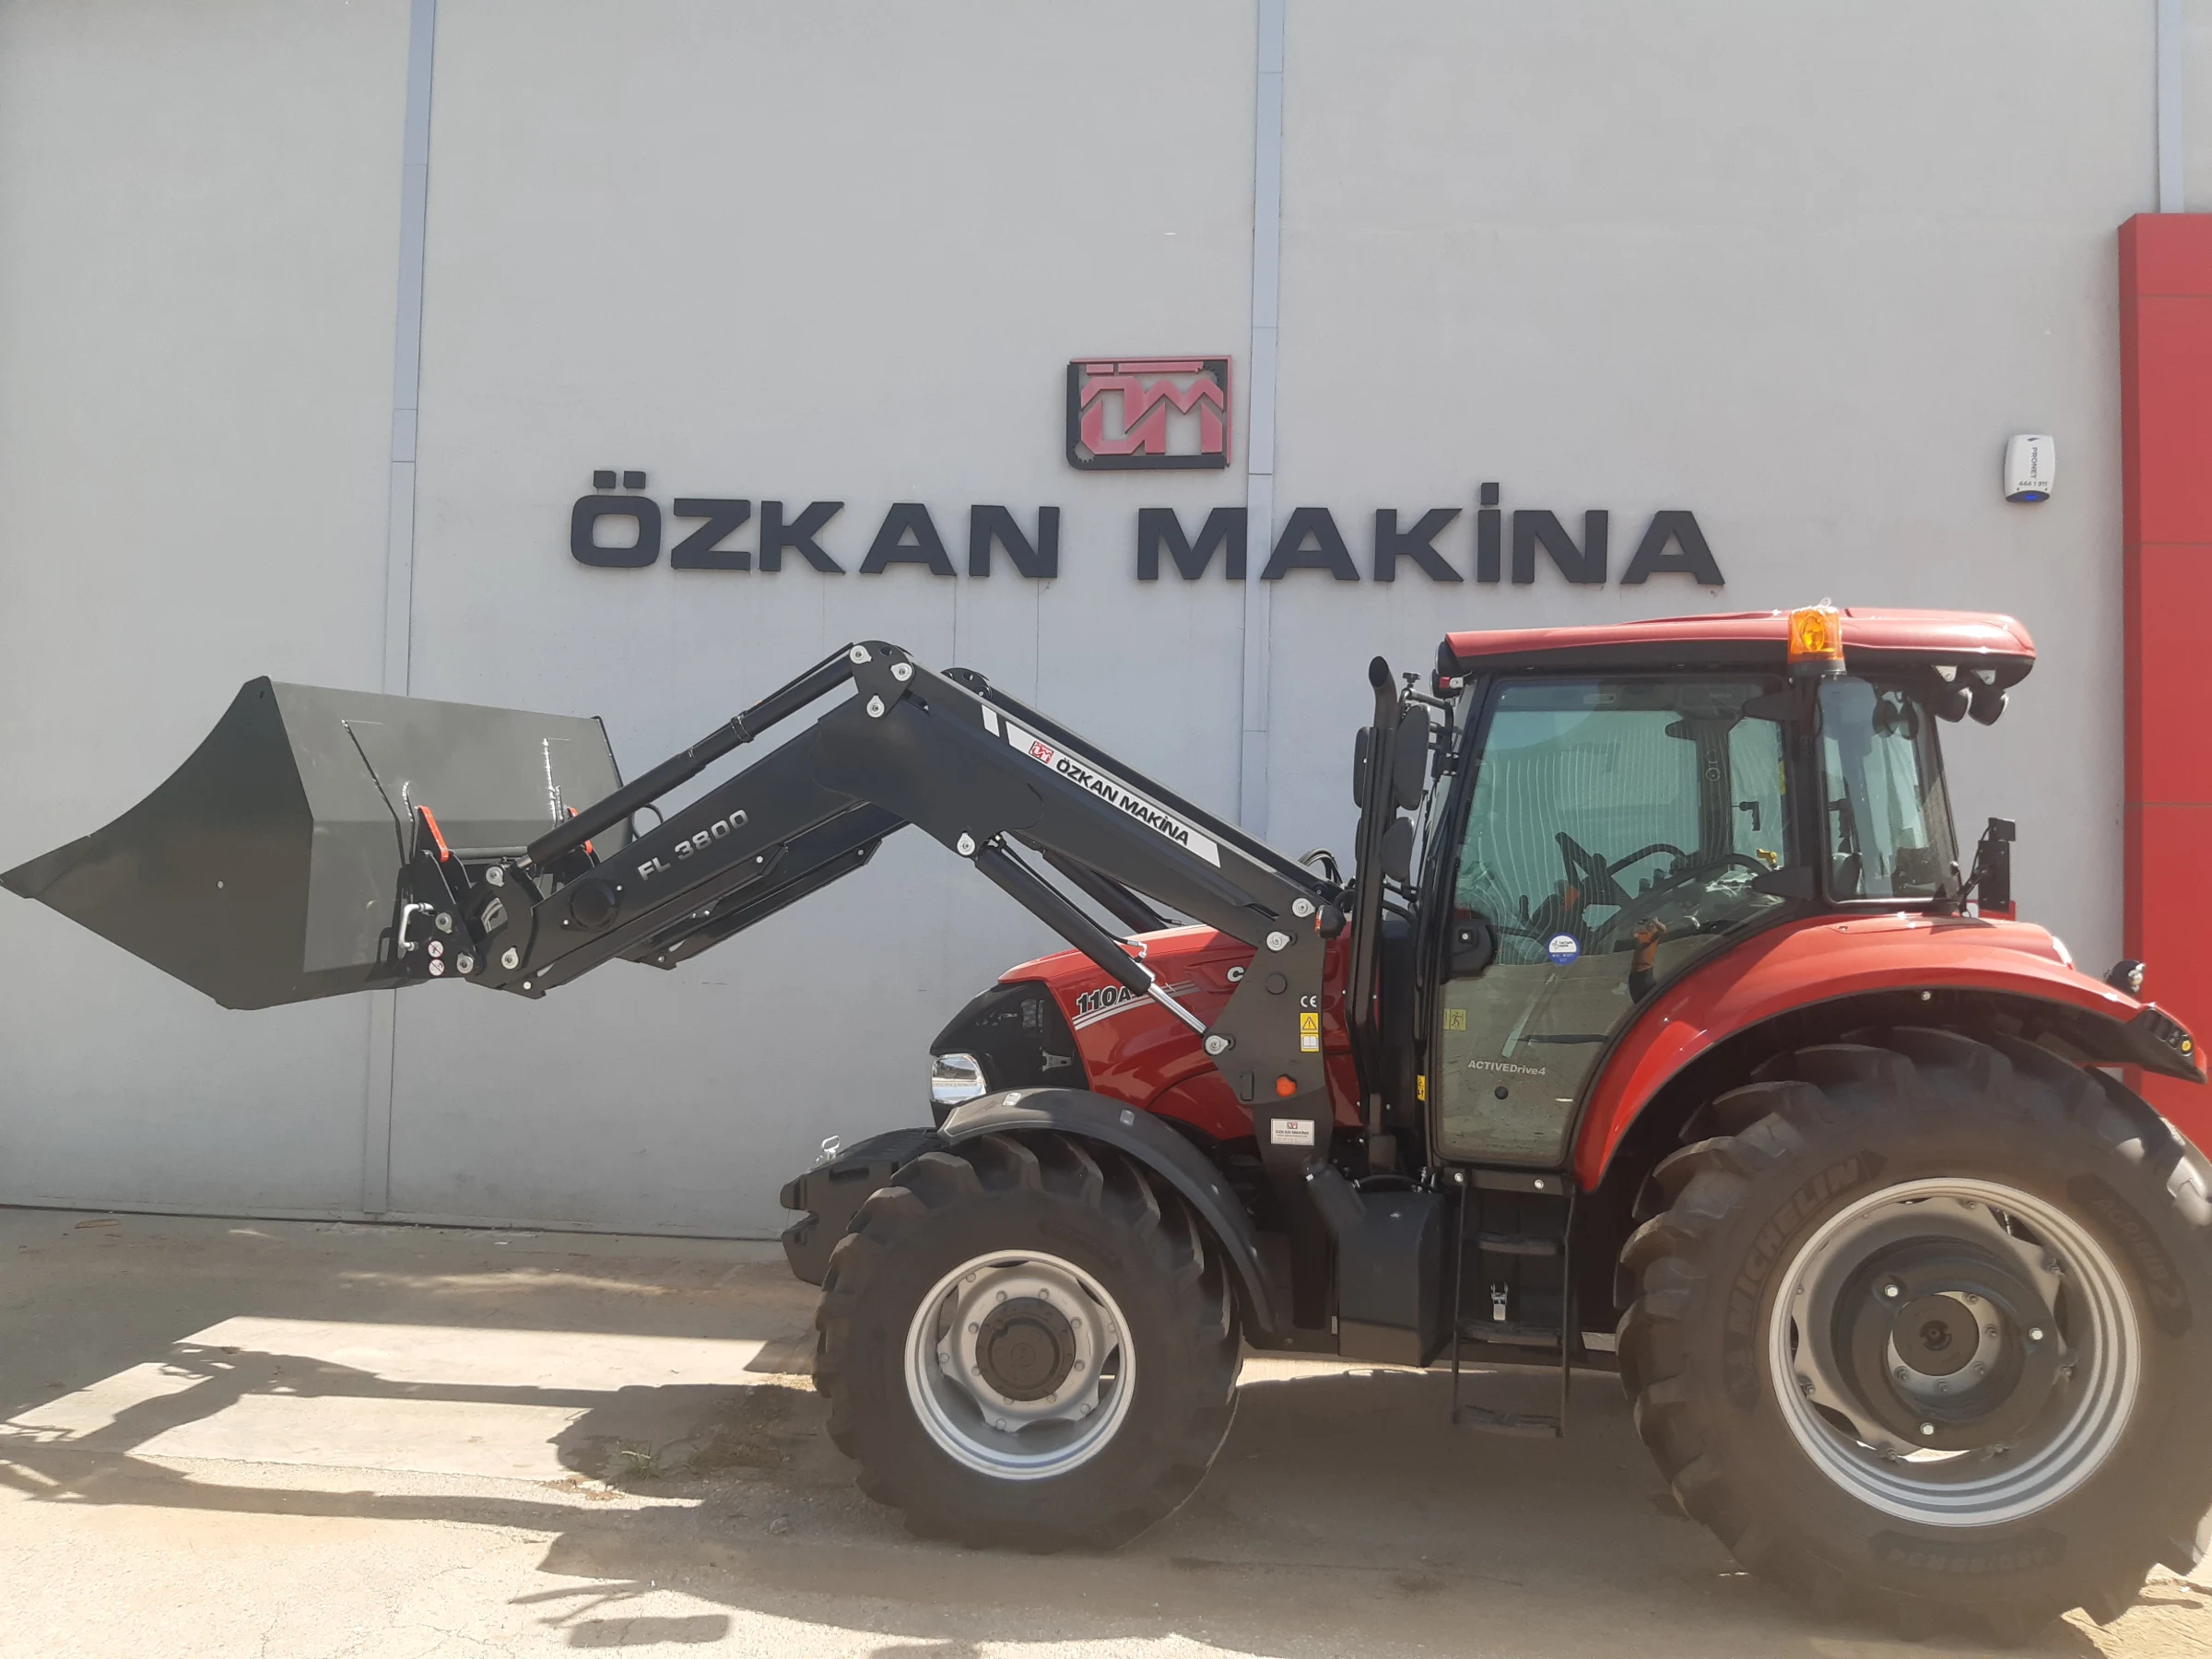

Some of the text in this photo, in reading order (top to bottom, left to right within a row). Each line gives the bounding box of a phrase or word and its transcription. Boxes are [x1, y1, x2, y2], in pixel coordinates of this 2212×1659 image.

[2030, 447, 2038, 478] PRONET
[570, 470, 1725, 585] ÖZKAN MAKİNA
[1055, 758, 1189, 846] ÖZKAN MAKİNA
[638, 809, 748, 881] FL 3800
[1300, 995, 1317, 1007] CE
[1467, 1059, 1547, 1077] ACTIVEDrive4
[1728, 1157, 1859, 1335] MICHELIN
